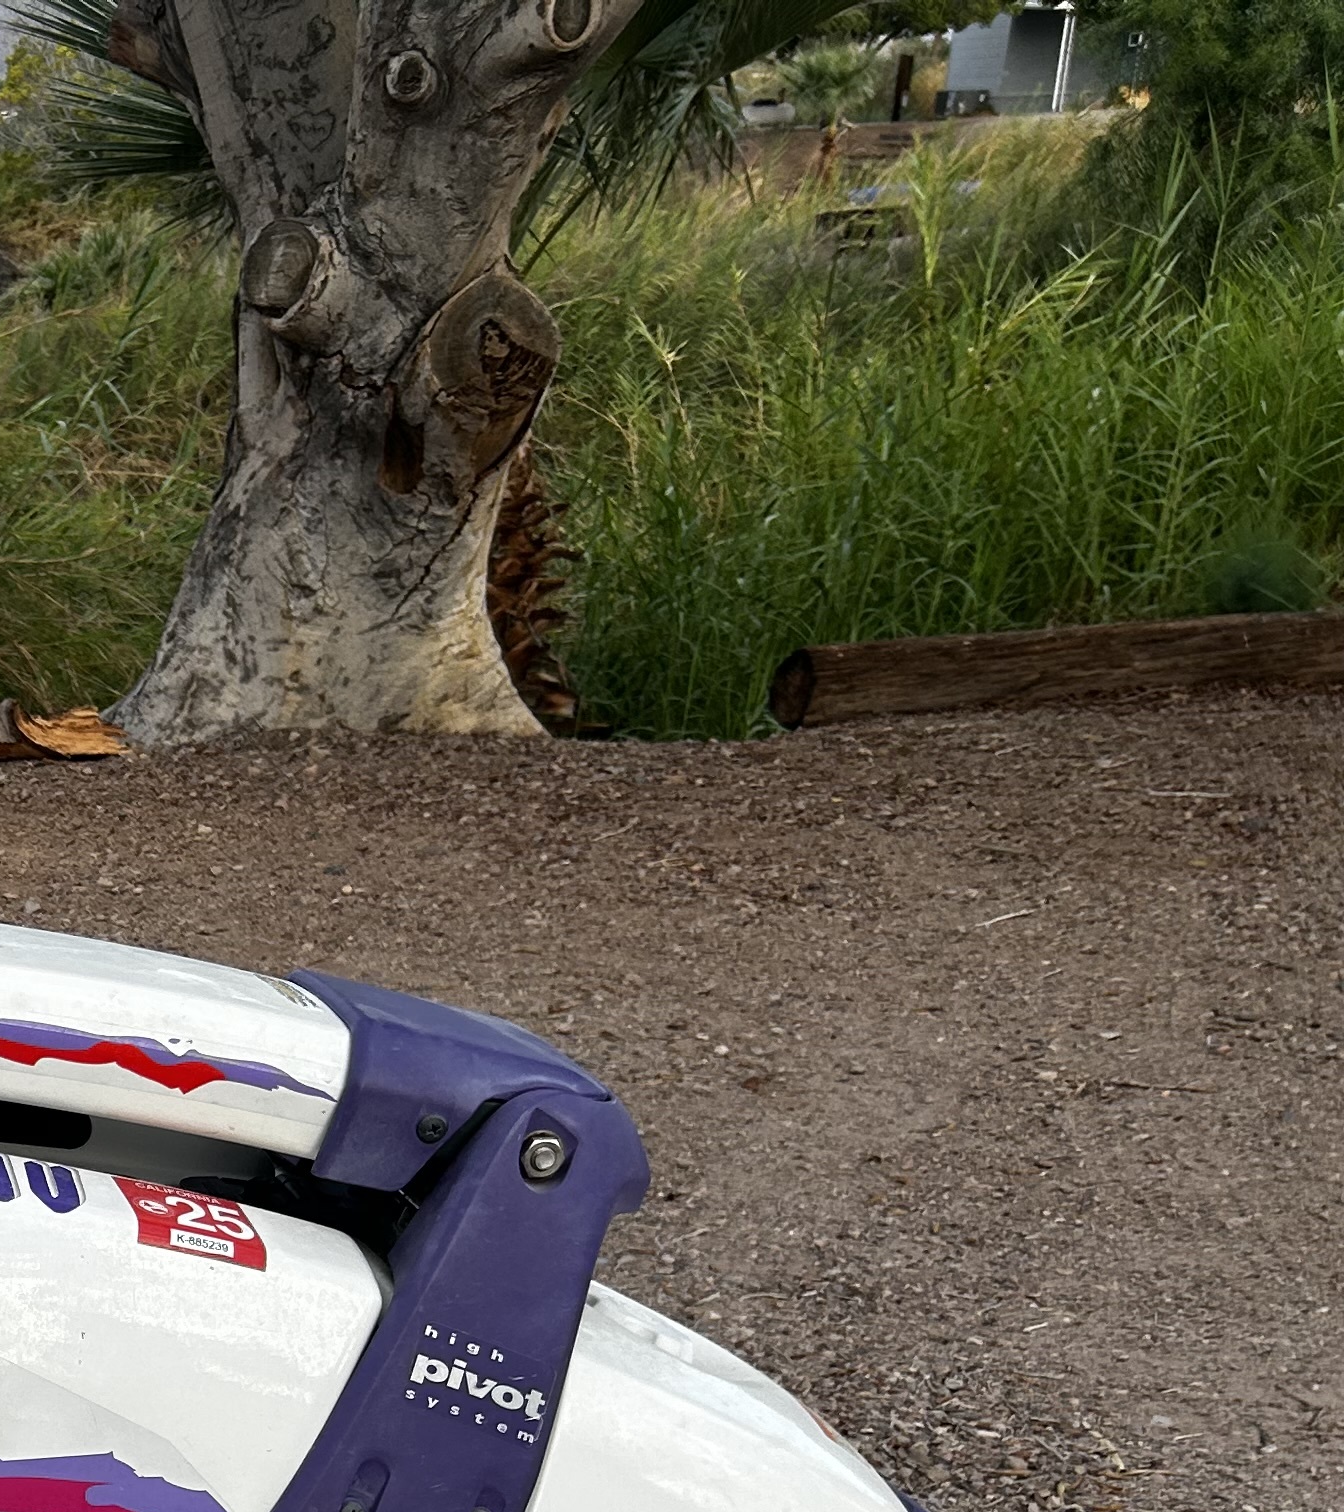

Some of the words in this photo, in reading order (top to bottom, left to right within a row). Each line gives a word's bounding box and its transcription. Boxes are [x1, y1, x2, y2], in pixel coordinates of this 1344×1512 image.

[134, 1182, 221, 1205] CALIFORNIA
[165, 1196, 255, 1240] 25
[424, 1324, 504, 1363] high
[410, 1353, 546, 1421] pivot
[405, 1389, 534, 1444] system
